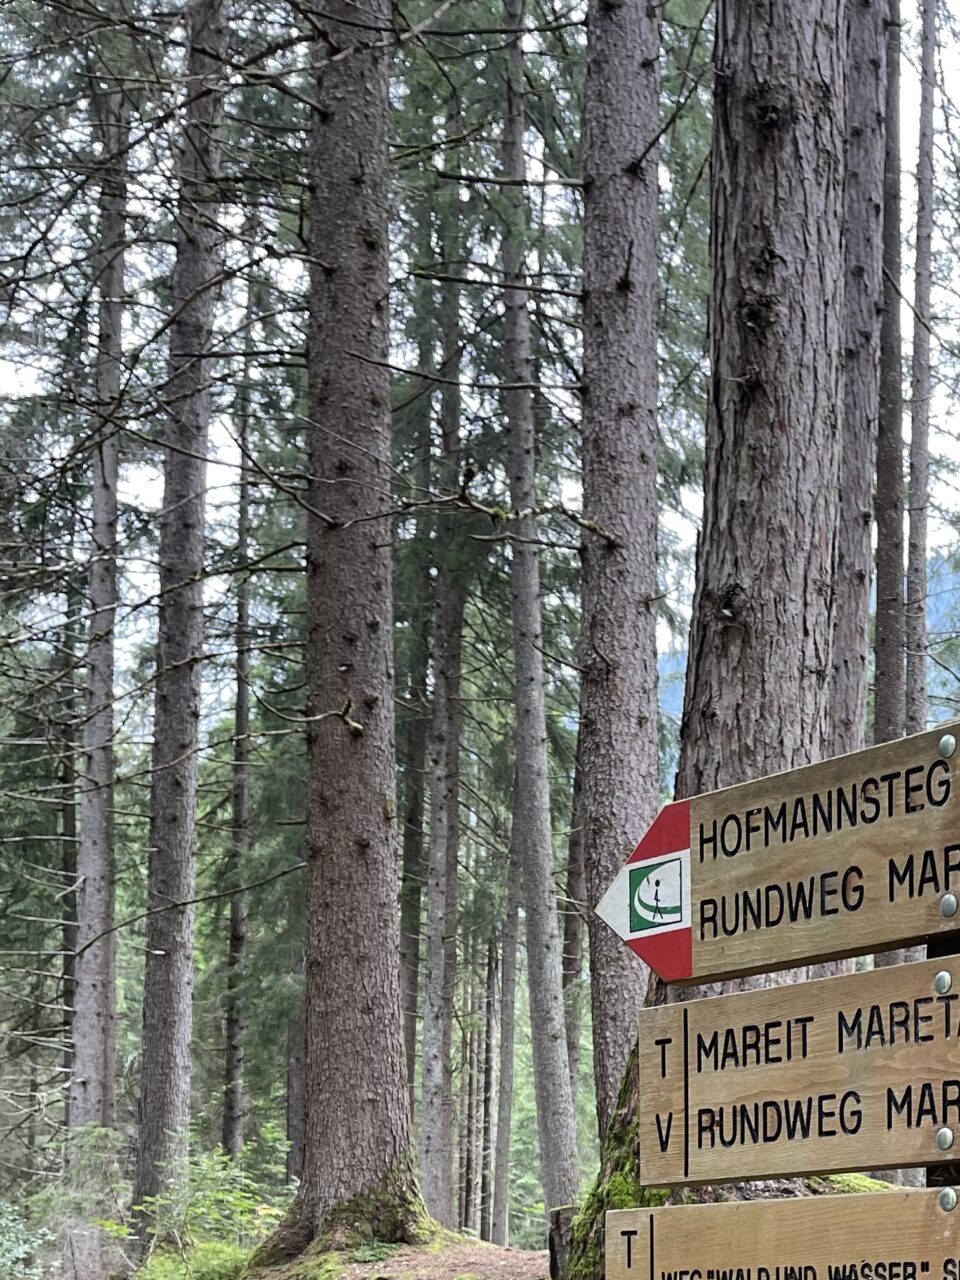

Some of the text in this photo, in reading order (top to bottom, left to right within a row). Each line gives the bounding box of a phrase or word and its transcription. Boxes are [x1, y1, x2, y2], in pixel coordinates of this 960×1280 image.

[698, 758, 952, 864] HOFMANNSTEG
[699, 864, 866, 942] RUNDWEG
[654, 1037, 673, 1079] T
[696, 1015, 816, 1074] MAREIT
[655, 1111, 673, 1154] V
[697, 1090, 863, 1150] RUNDWEG
[620, 1229, 638, 1270] T
